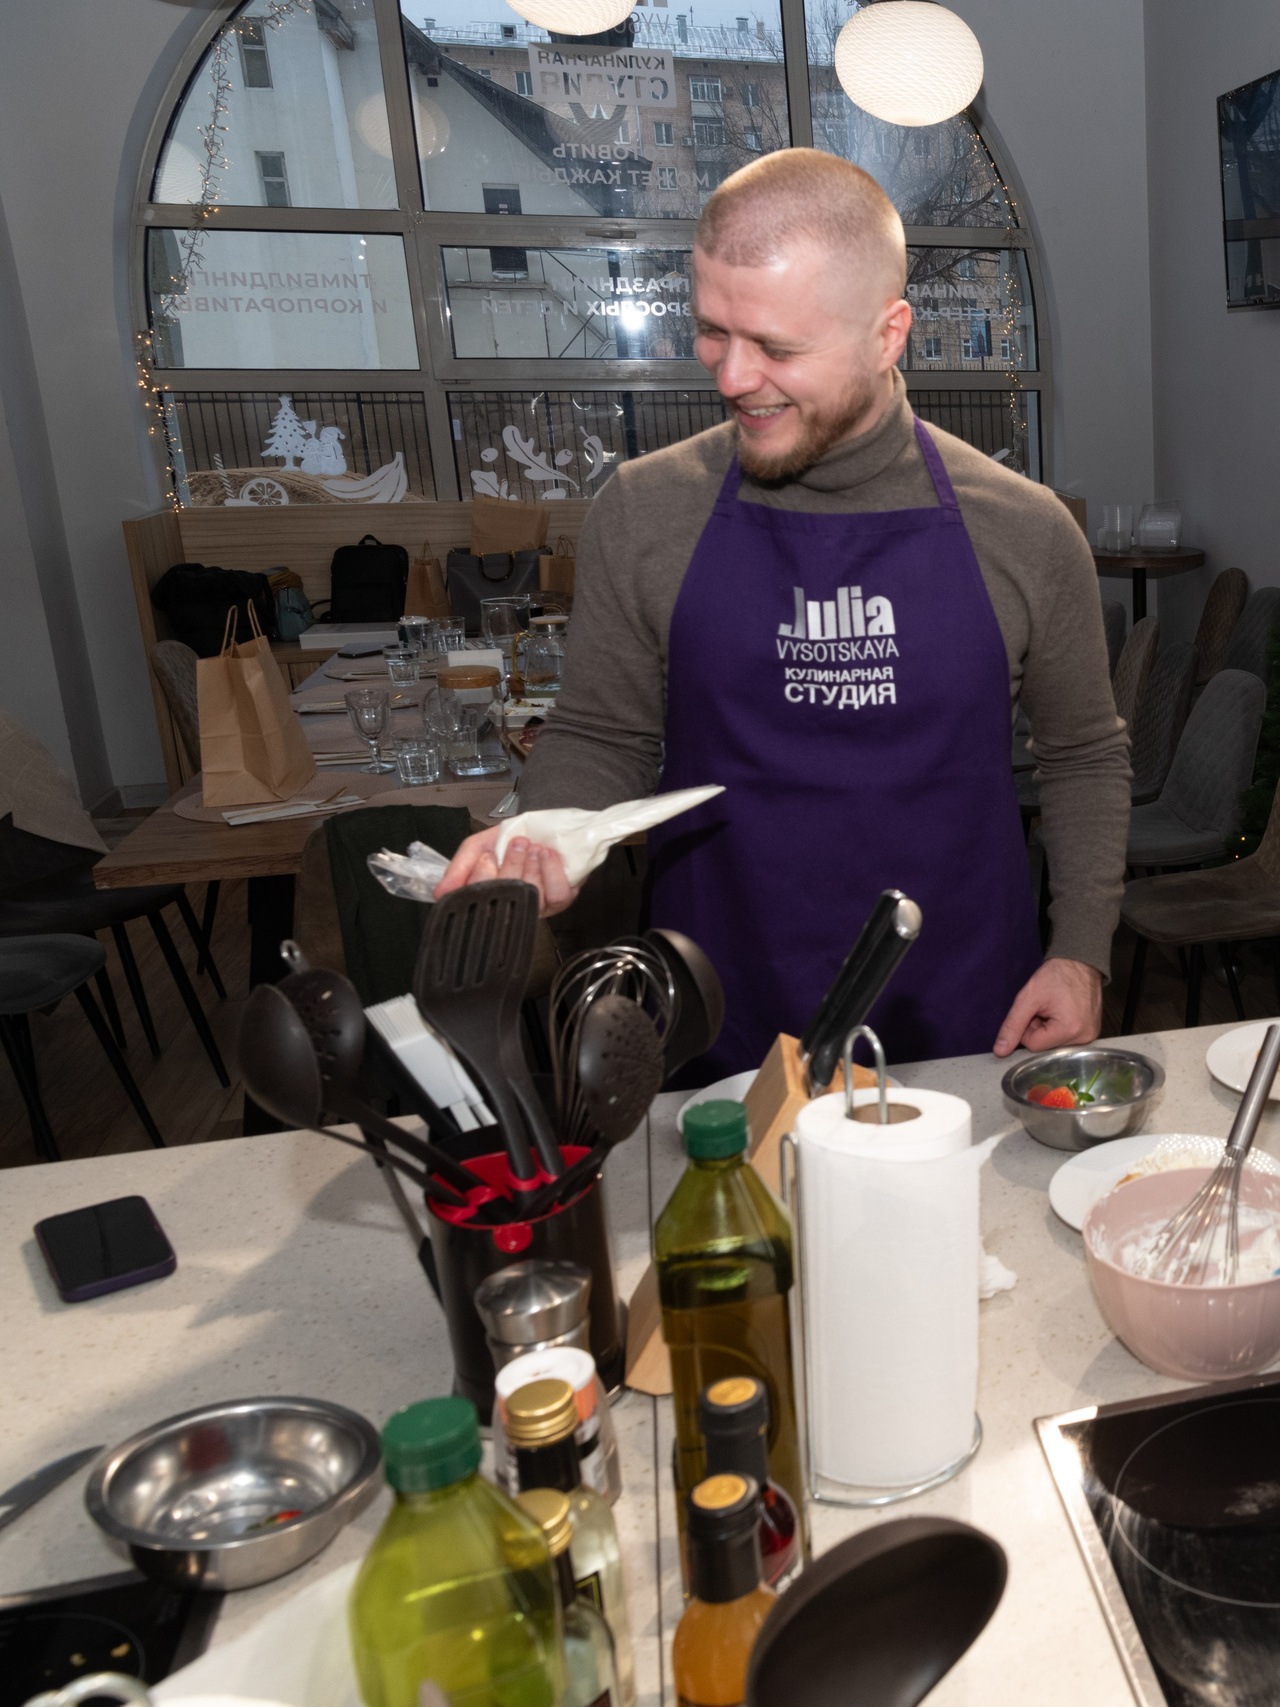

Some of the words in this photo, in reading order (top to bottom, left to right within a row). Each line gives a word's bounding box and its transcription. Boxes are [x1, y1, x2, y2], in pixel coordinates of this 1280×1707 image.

[777, 585, 896, 641] Julia
[776, 637, 900, 663] VYSOTSKAYA
[784, 666, 894, 683] КУЛИНАРНАЯ
[784, 682, 897, 710] СТУДИЯ
